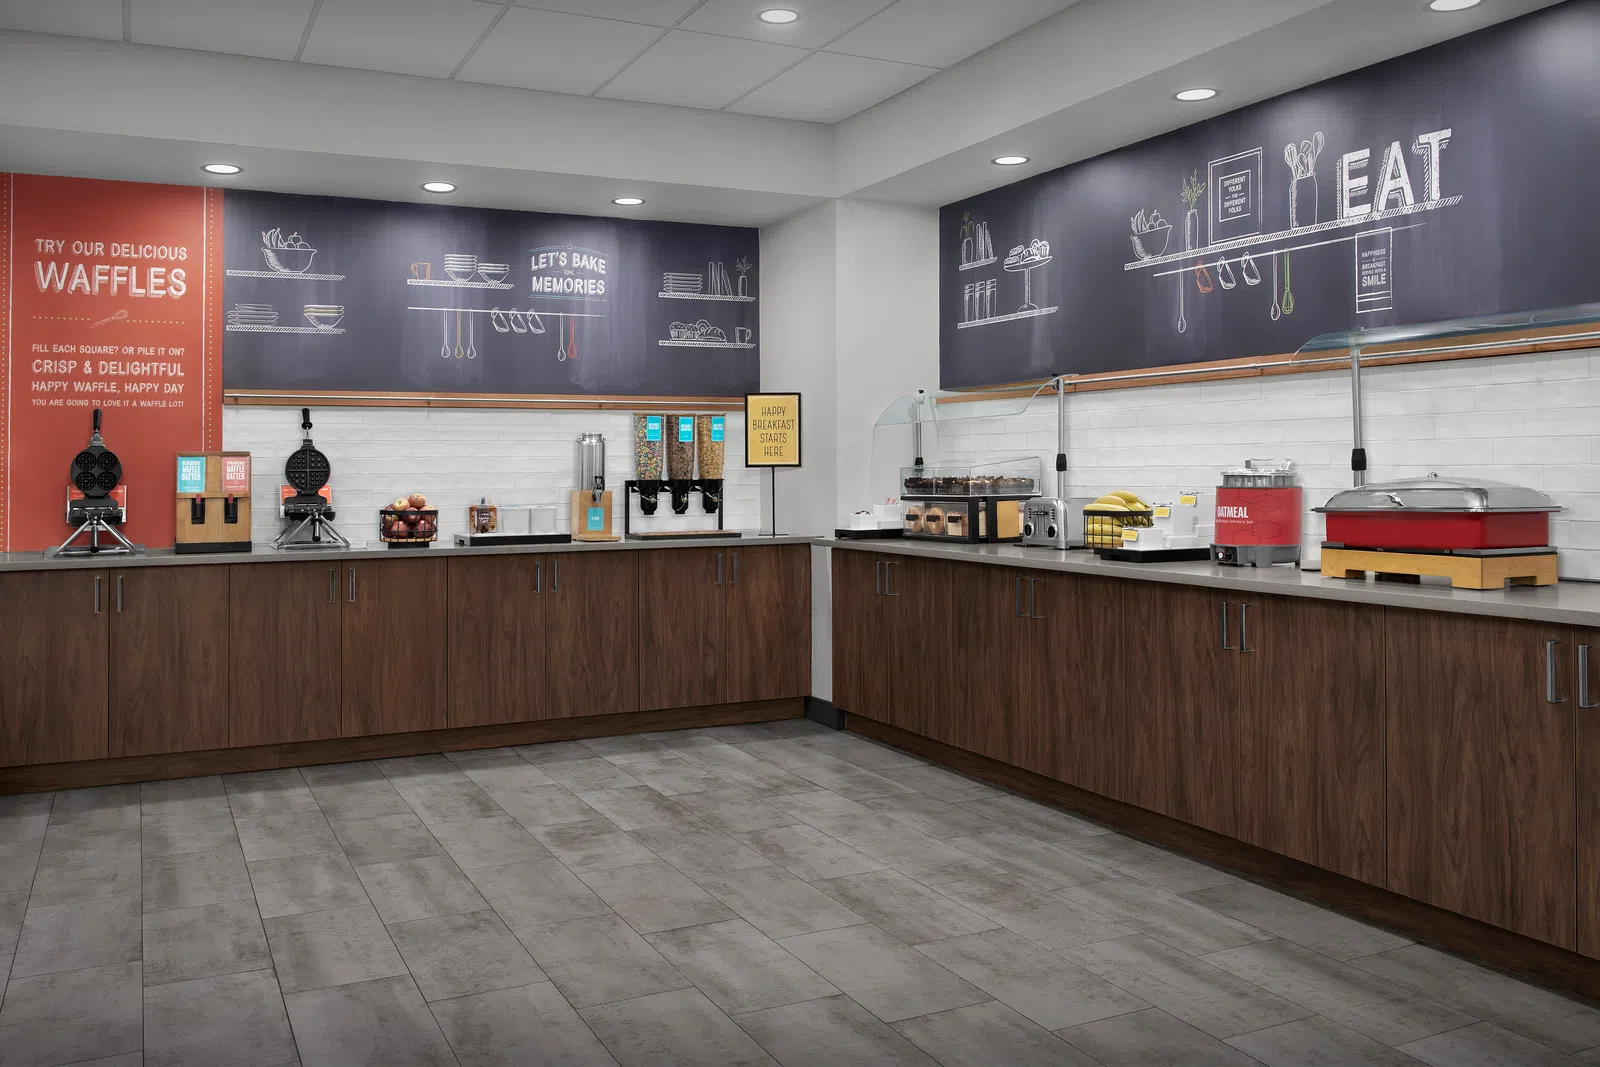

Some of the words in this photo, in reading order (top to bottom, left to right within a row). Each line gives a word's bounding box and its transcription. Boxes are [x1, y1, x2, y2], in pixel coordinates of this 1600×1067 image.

[1337, 128, 1452, 220] EAT
[1224, 176, 1246, 187] DIFFERENT
[1224, 197, 1246, 208] DIFFERENT
[1228, 206, 1241, 214] FOLKS
[36, 238, 65, 254] TRY
[72, 240, 104, 256] OUR
[110, 243, 187, 261] DELICIOUS
[1362, 248, 1386, 258] HAPPINESS
[531, 252, 567, 271] LET'S
[572, 253, 606, 274] BAKE
[1362, 261, 1386, 270] BREAKFAST
[34, 261, 187, 299] WAFFLES
[532, 276, 605, 295] MEMORIES
[1362, 274, 1386, 287] SMILE
[32, 344, 49, 353] FILL
[53, 344, 76, 353] EACH
[80, 346, 118, 355] SQUARE?
[122, 346, 134, 354] OR
[137, 347, 155, 355] PILE
[168, 348, 184, 356] ON?
[32, 360, 77, 374] CRISP
[83, 360, 92, 374] &
[98, 361, 184, 376] DELIGHTFUL
[32, 381, 69, 392] HAPPY
[73, 382, 120, 394] WAFFLE,
[125, 383, 160, 393] HAPPY
[164, 383, 184, 393] DAY
[762, 406, 786, 416] HAPPY
[752, 419, 795, 430] BREAKFAST
[760, 433, 787, 443] STARTS
[764, 446, 783, 456] HERE
